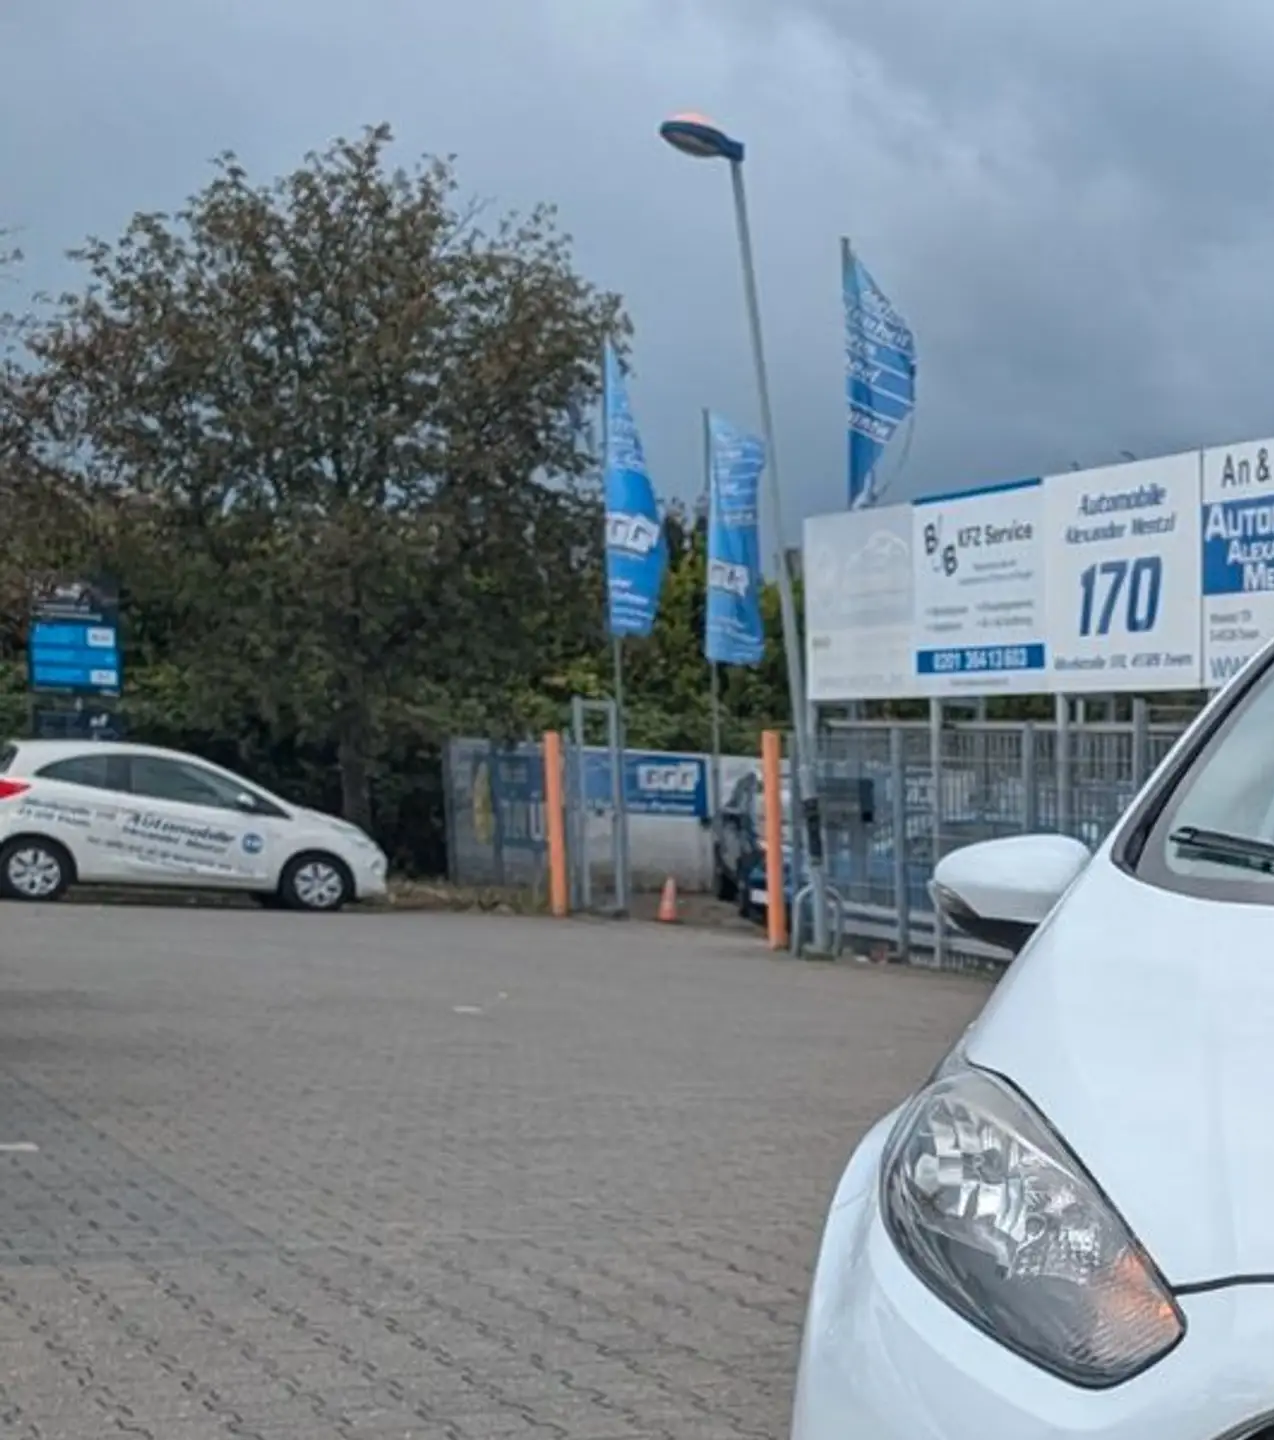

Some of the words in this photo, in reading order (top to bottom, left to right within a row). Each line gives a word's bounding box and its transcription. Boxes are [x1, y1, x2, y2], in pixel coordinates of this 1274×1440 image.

[1221, 453, 1250, 488] An
[1255, 448, 1271, 482] &
[1079, 482, 1166, 516] Automobile
[957, 525, 981, 548] KFZ
[985, 520, 1033, 545] Service
[1065, 520, 1126, 544] Alexander
[1079, 556, 1163, 637] 170
